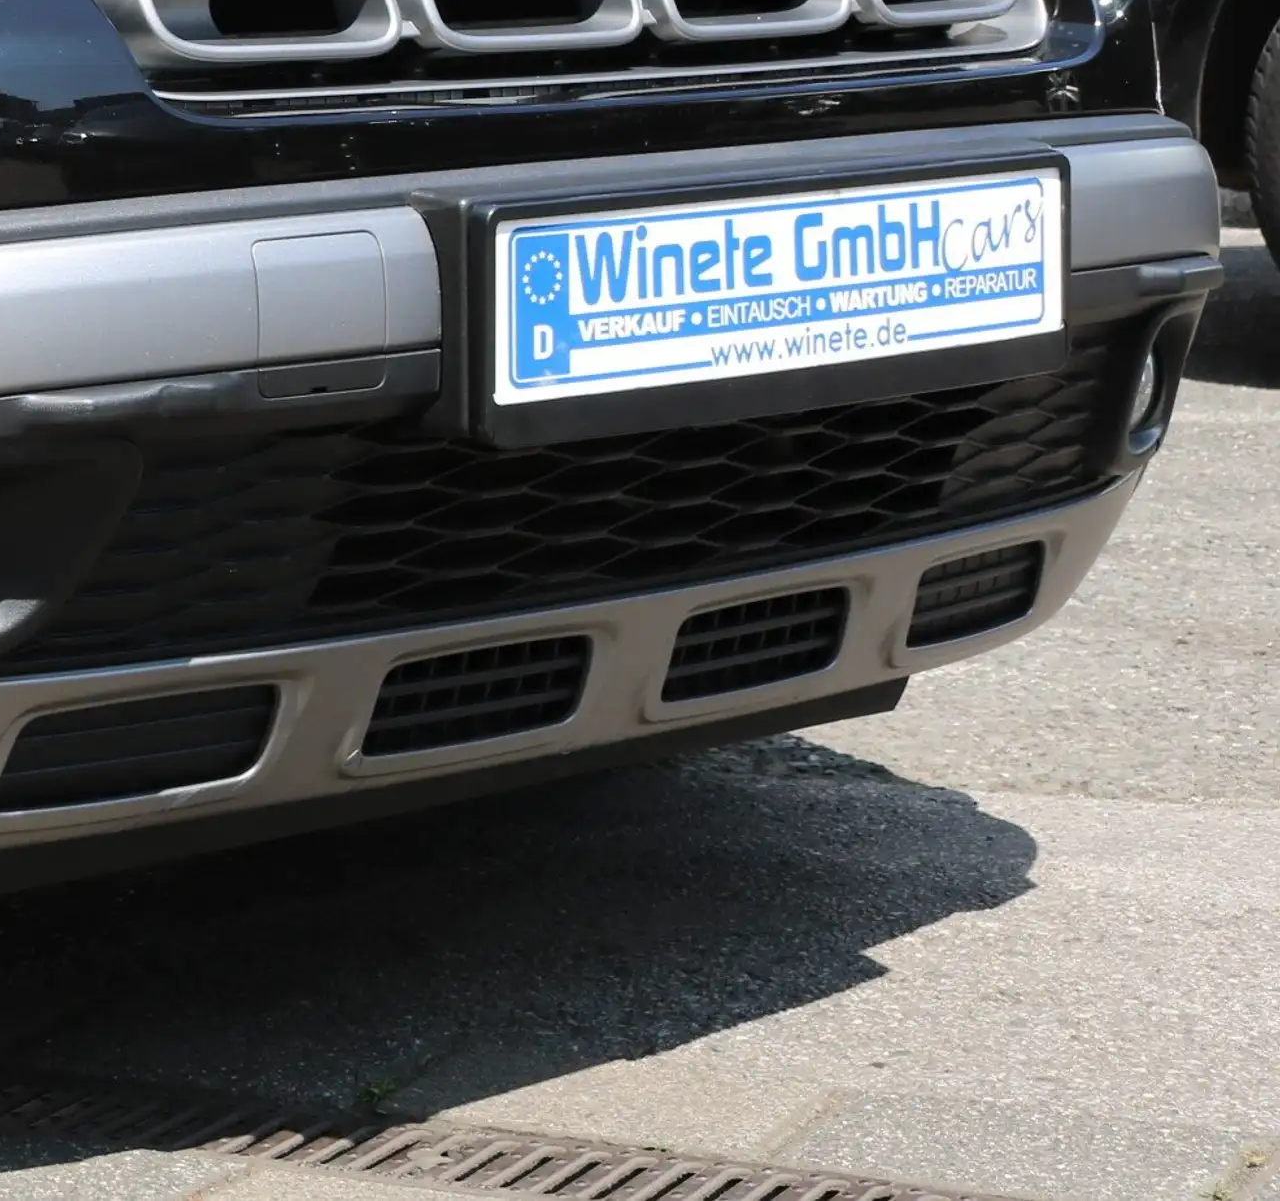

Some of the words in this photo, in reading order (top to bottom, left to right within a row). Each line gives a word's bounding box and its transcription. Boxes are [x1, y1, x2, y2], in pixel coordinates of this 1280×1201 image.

[574, 218, 773, 306] Winete
[794, 200, 941, 282] GmbH
[942, 199, 1044, 272] Cars
[577, 309, 686, 342] VERKAUF
[706, 296, 812, 328] EINTAUSCH
[829, 282, 928, 314] WARTUNG
[944, 269, 1038, 299] REPARATUR
[533, 324, 554, 361] D
[711, 318, 907, 366] www.winete.de
